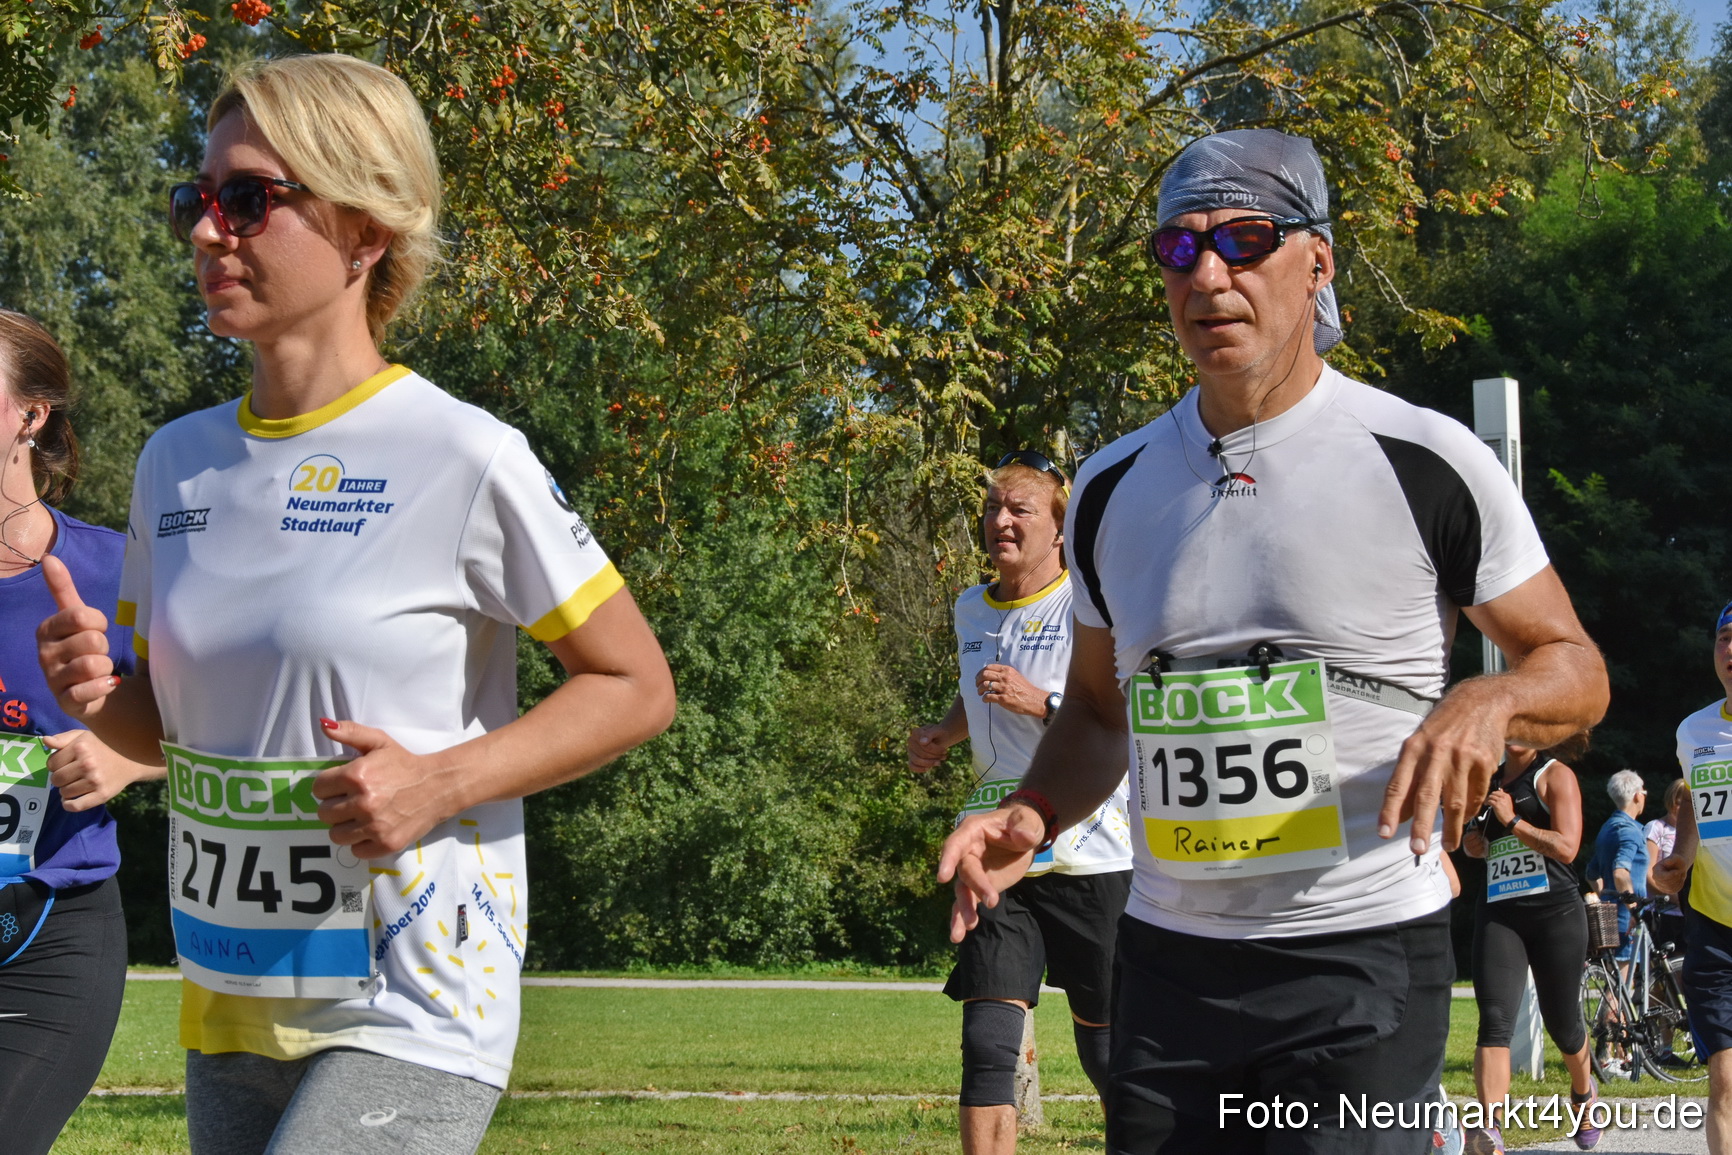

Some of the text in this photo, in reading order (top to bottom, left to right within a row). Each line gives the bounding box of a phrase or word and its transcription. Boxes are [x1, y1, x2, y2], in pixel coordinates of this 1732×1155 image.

[293, 465, 383, 493] 20 JAHRE
[158, 508, 211, 531] BOCK
[286, 497, 394, 514] Neumarkter
[280, 517, 367, 536] Stadtlauf
[1023, 620, 1043, 633] 20
[1136, 671, 1308, 727] BOCK
[0, 699, 28, 728] S
[1152, 738, 1309, 808] 1356
[173, 754, 333, 823] BOCK
[28, 801, 37, 811] D
[1699, 790, 1732, 818] 27
[1174, 827, 1280, 855] Rainer
[182, 830, 336, 915] 2745
[1492, 854, 1537, 880] 2425
[411, 881, 437, 916] 2019
[1498, 880, 1531, 893] MARIA
[471, 882, 496, 927] 14./15.
[190, 930, 256, 965] ANNA
